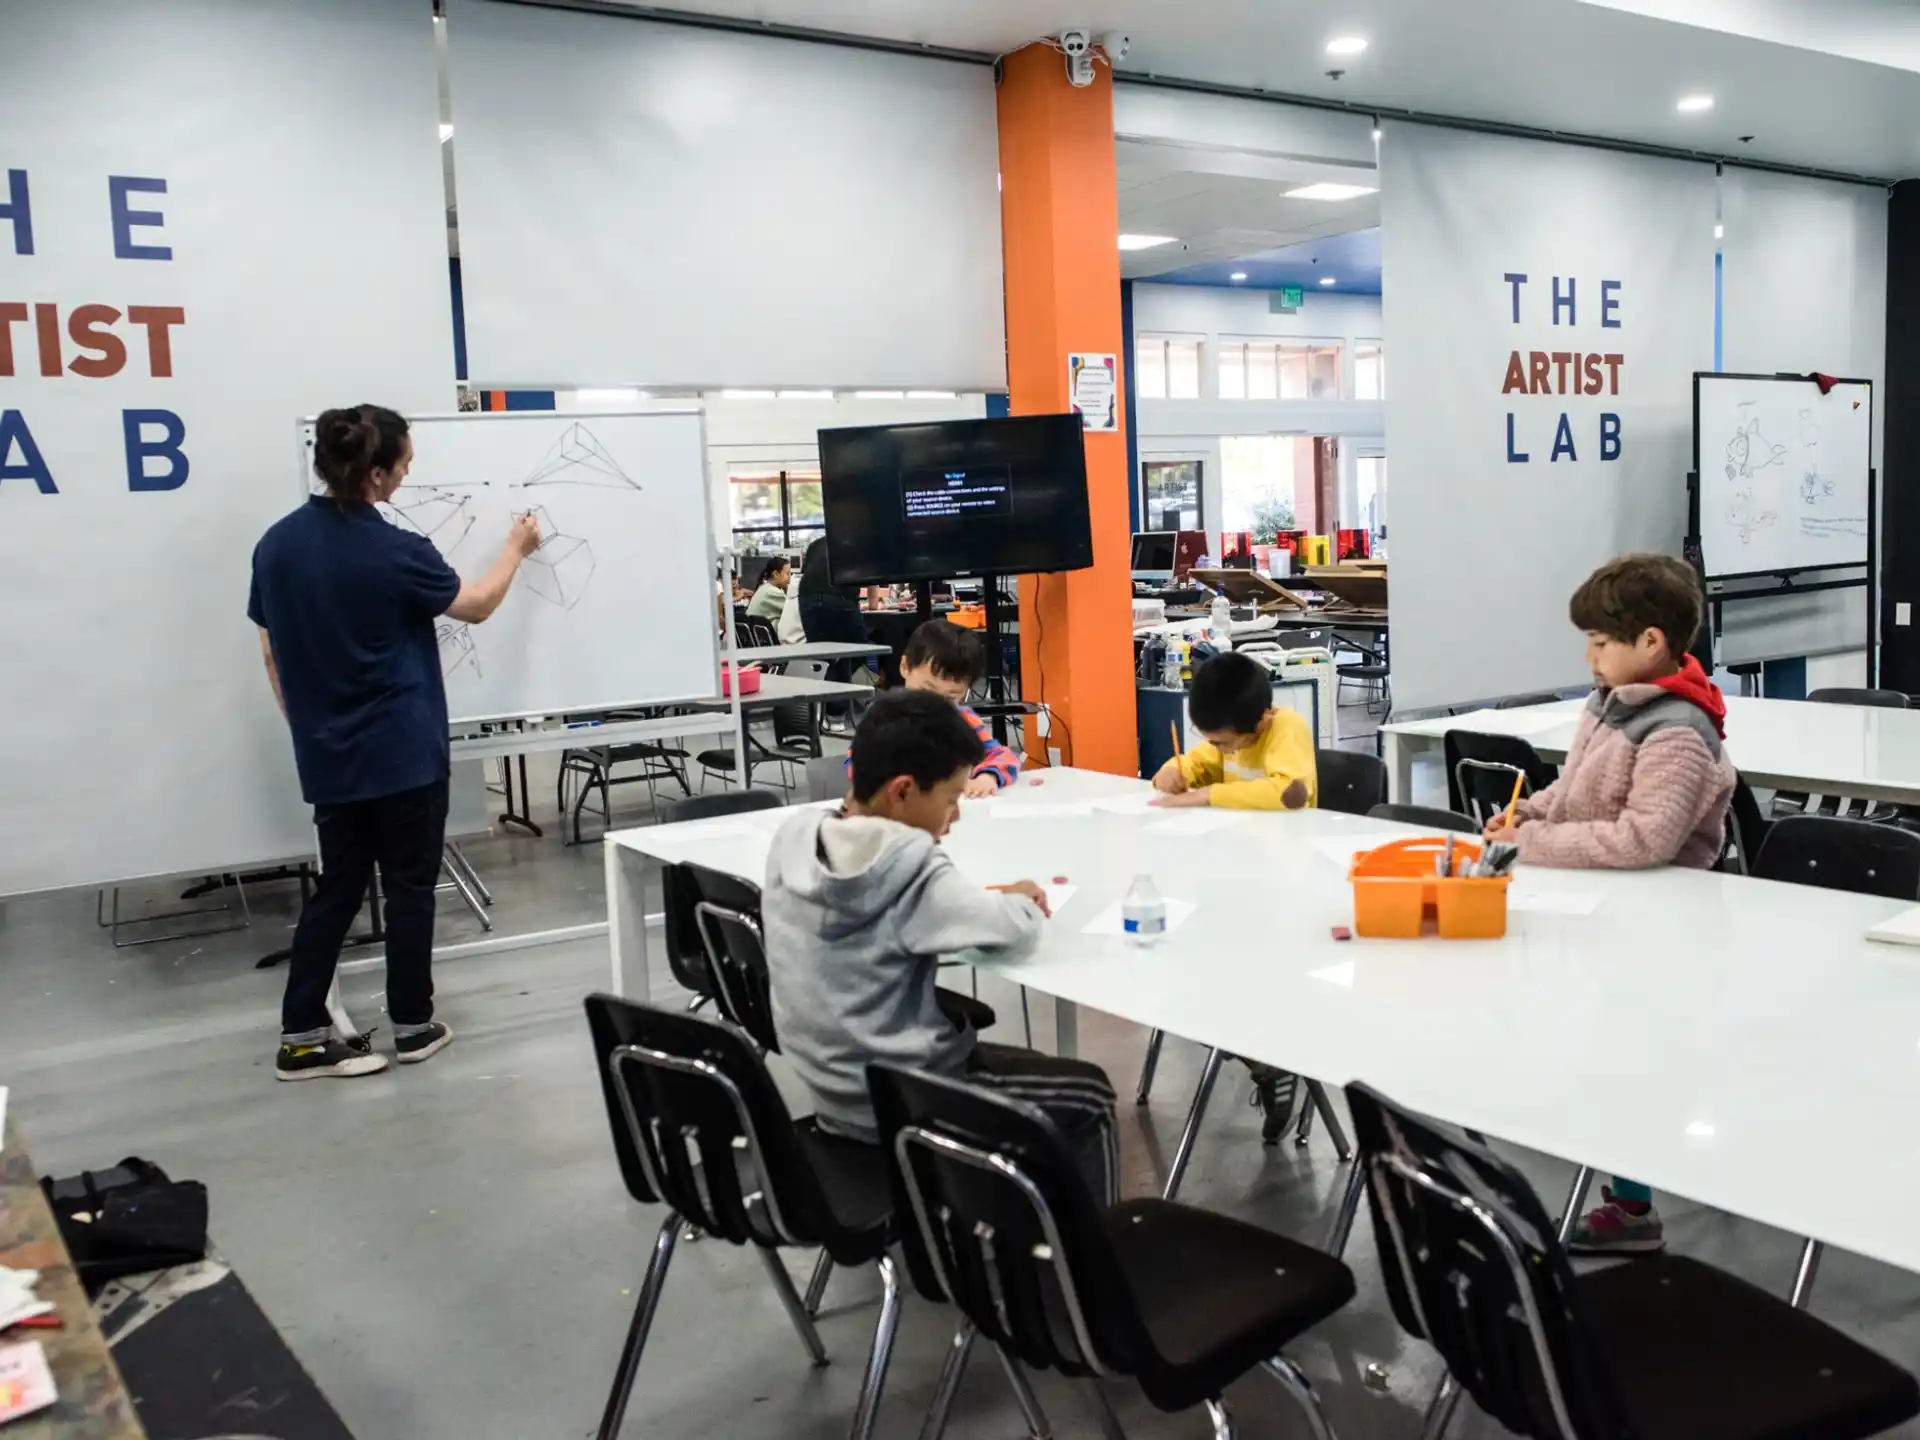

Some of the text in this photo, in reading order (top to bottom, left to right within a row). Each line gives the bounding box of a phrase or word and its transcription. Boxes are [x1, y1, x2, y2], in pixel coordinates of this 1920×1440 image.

[1504, 272, 1622, 328] THE
[1502, 350, 1624, 396] ARTIST
[1506, 412, 1622, 463] LAB
